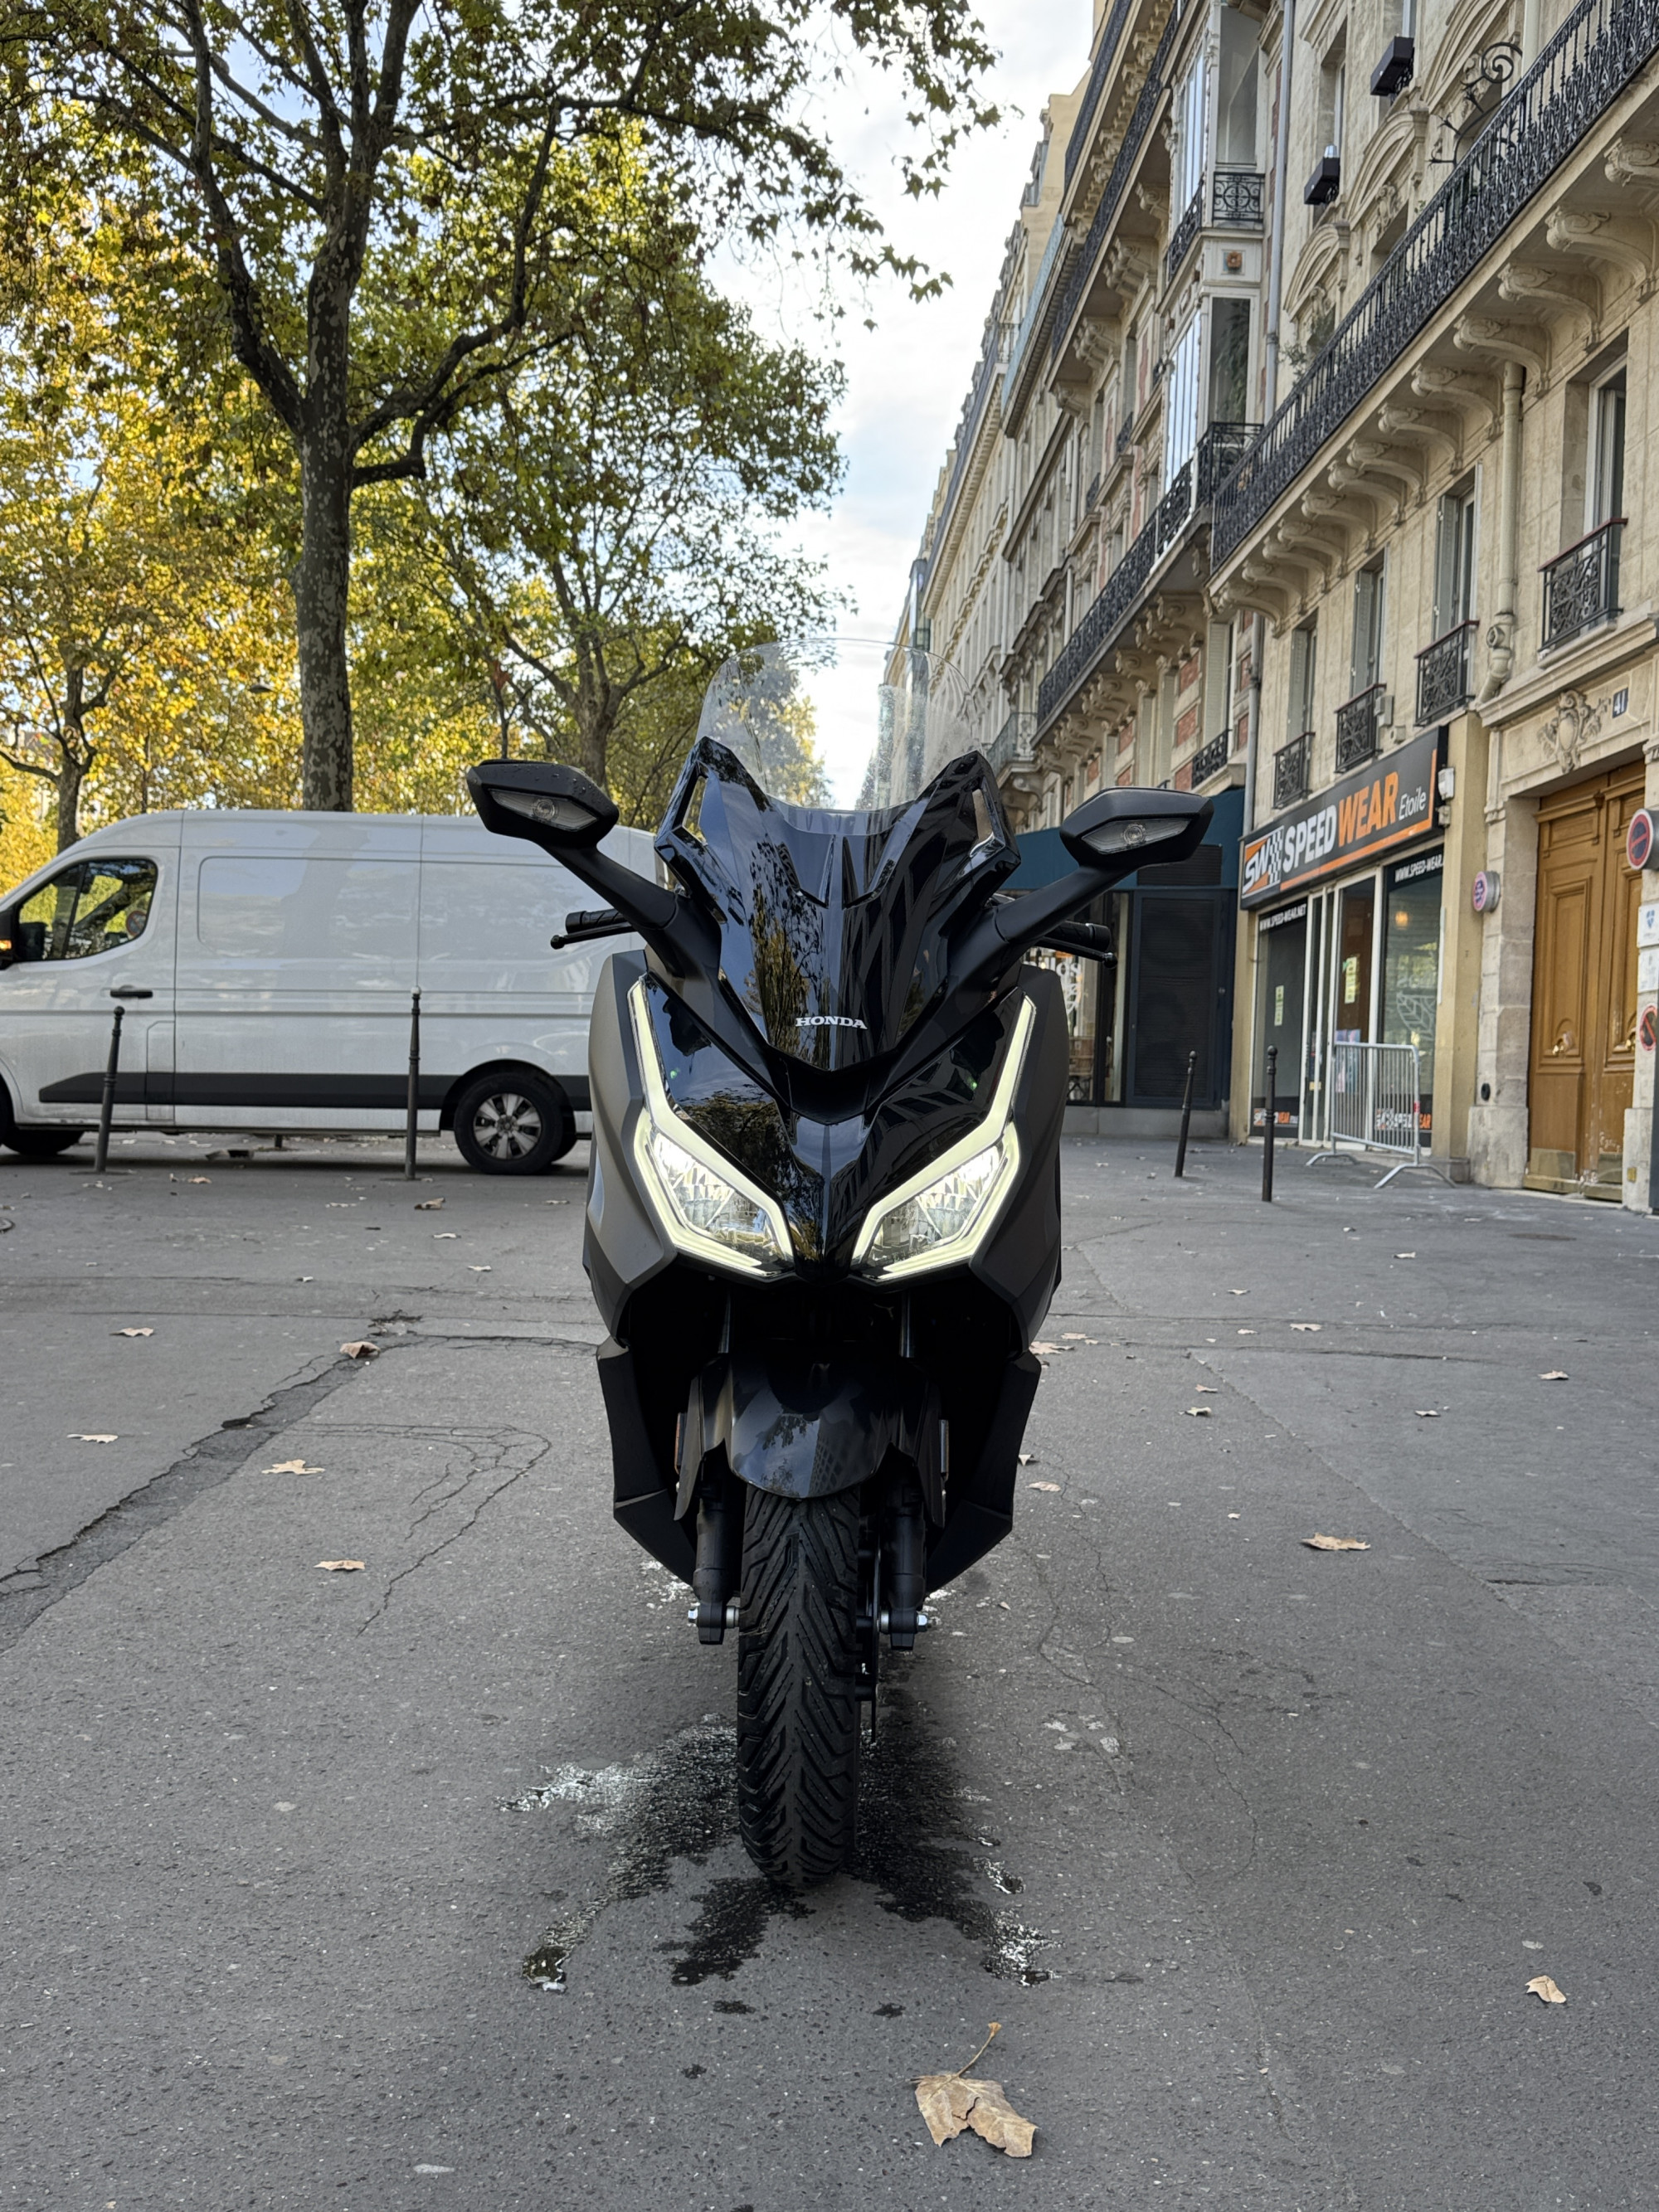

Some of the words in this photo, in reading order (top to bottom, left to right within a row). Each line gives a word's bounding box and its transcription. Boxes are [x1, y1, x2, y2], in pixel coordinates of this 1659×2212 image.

[1614, 689, 1626, 715] 41
[1243, 838, 1271, 895] SW
[1283, 805, 1337, 873] SPEED
[1338, 771, 1399, 848] WEAR
[1399, 786, 1426, 821] Etoile
[795, 1016, 867, 1029] HONDA
